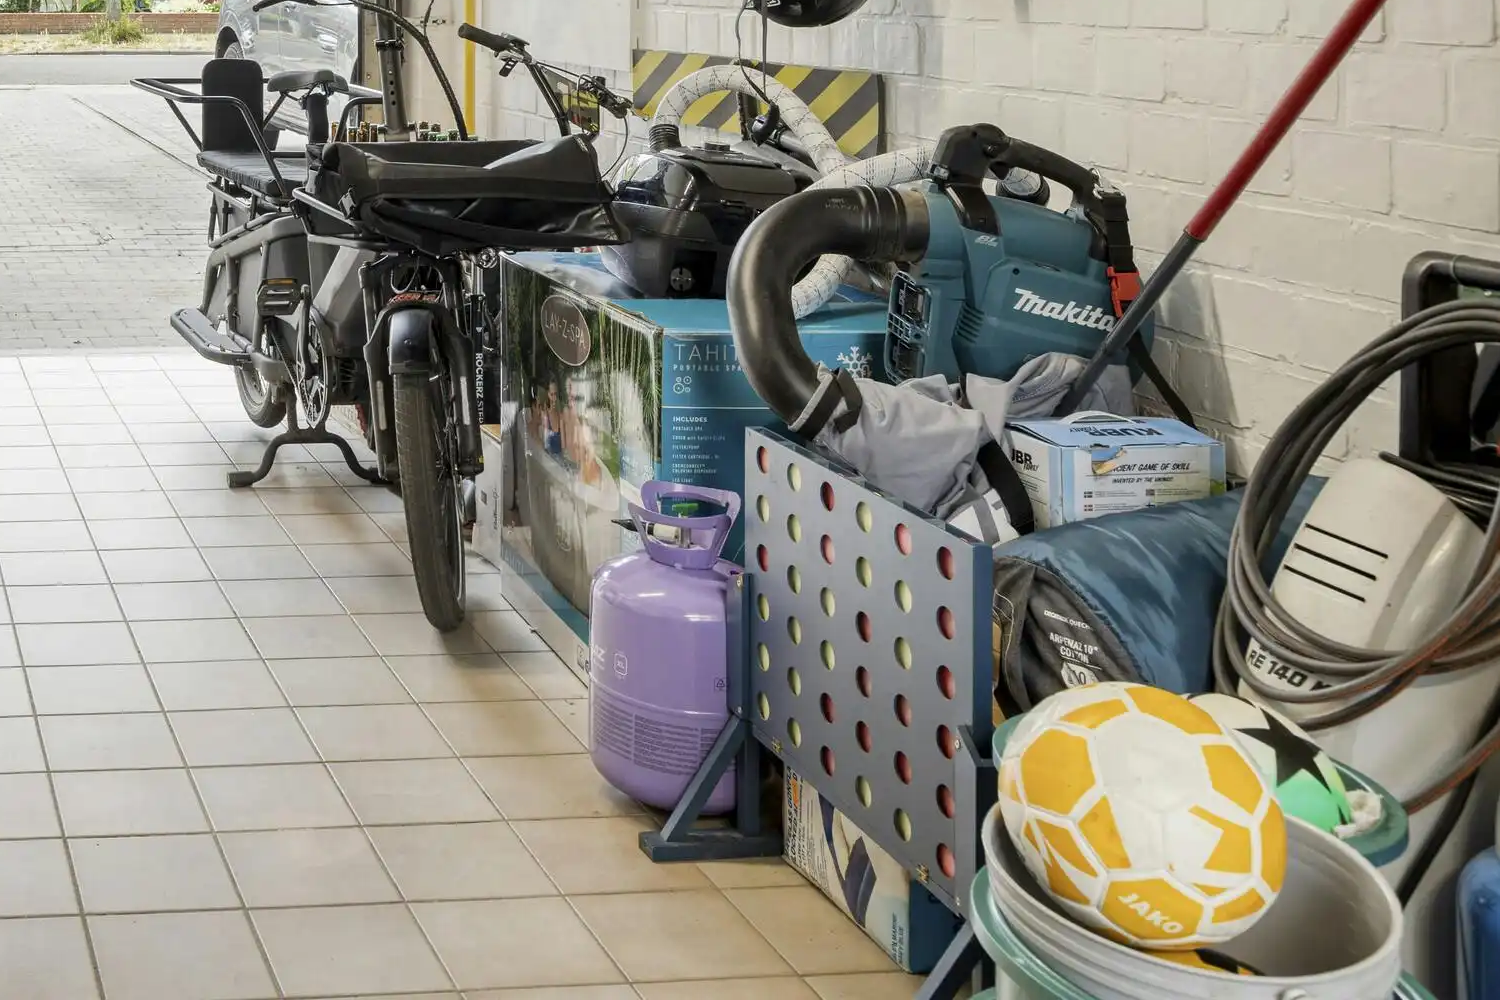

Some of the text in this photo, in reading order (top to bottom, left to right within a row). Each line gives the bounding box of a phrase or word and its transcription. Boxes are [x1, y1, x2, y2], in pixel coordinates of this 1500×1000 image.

[545, 309, 587, 349] LAY-Z-SPA
[673, 343, 741, 361] TAHIT
[475, 352, 485, 399] ROCKERZ
[672, 363, 721, 372] PORTABLE
[672, 415, 709, 423] INCLUDES
[1138, 463, 1159, 471] GAME
[1160, 462, 1171, 471] OF
[1171, 462, 1191, 471] SKILL
[1248, 649, 1267, 669] RE
[1267, 660, 1308, 688] 140
[1117, 892, 1184, 934] JAKO
